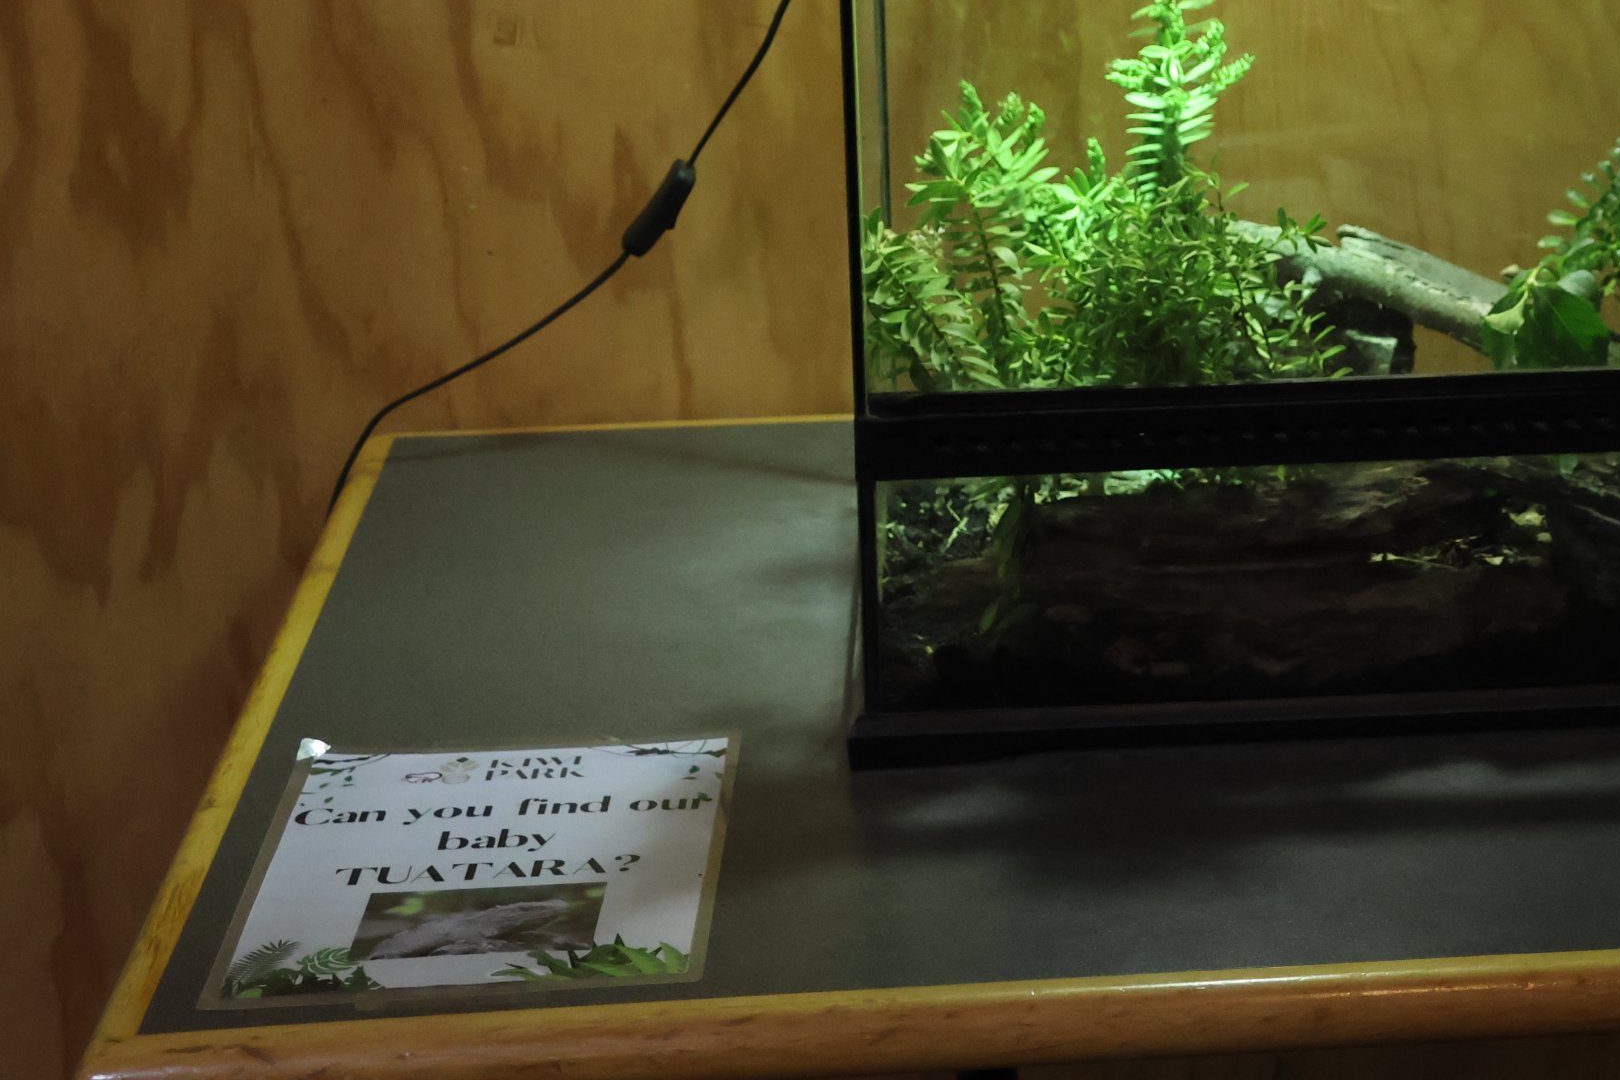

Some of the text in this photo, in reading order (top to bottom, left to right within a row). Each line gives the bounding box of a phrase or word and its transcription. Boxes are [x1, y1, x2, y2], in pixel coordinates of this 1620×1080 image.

[485, 766, 587, 781] PARK
[490, 754, 582, 769] KIWI
[293, 794, 713, 827] Can you find our
[436, 827, 558, 853] baby
[334, 852, 642, 887] TUATARA?
